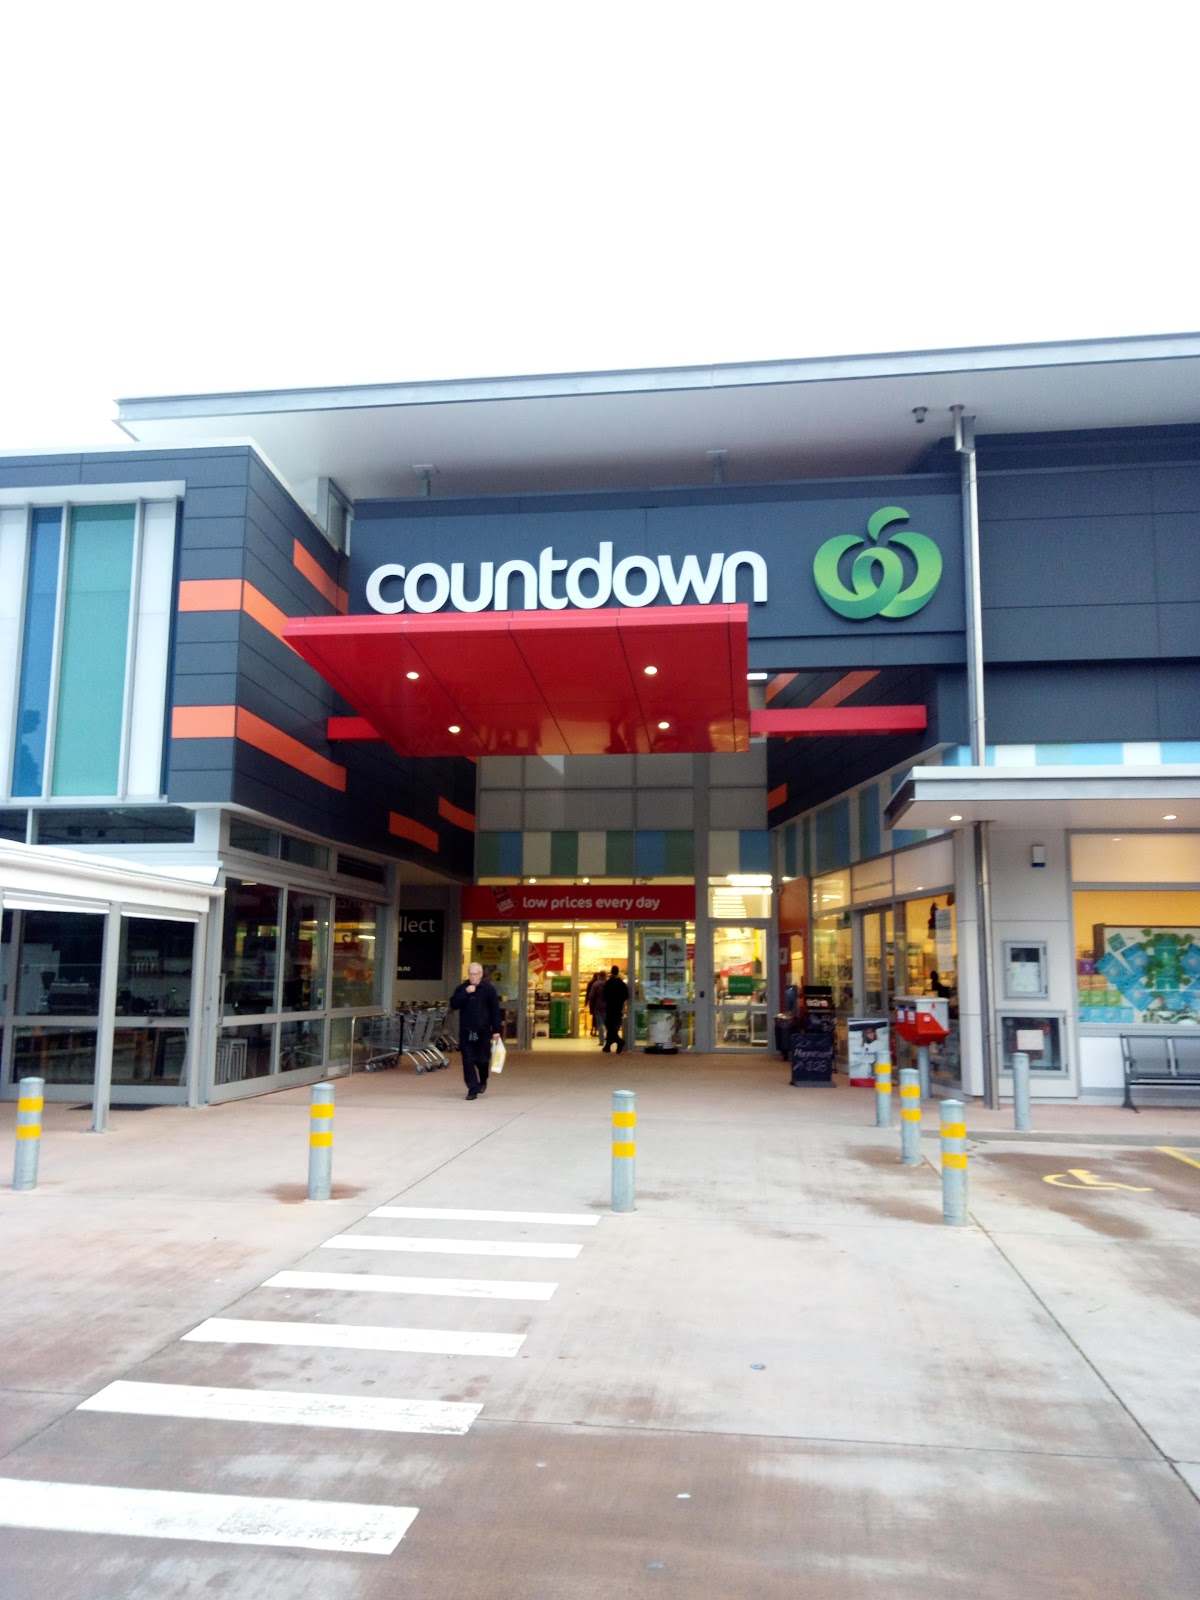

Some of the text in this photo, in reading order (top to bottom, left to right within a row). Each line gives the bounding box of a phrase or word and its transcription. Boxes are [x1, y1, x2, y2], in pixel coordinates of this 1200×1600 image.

[366, 541, 768, 614] countdown
[523, 897, 547, 908] low
[551, 897, 592, 911] prices
[595, 899, 632, 911] every
[635, 897, 660, 911] day
